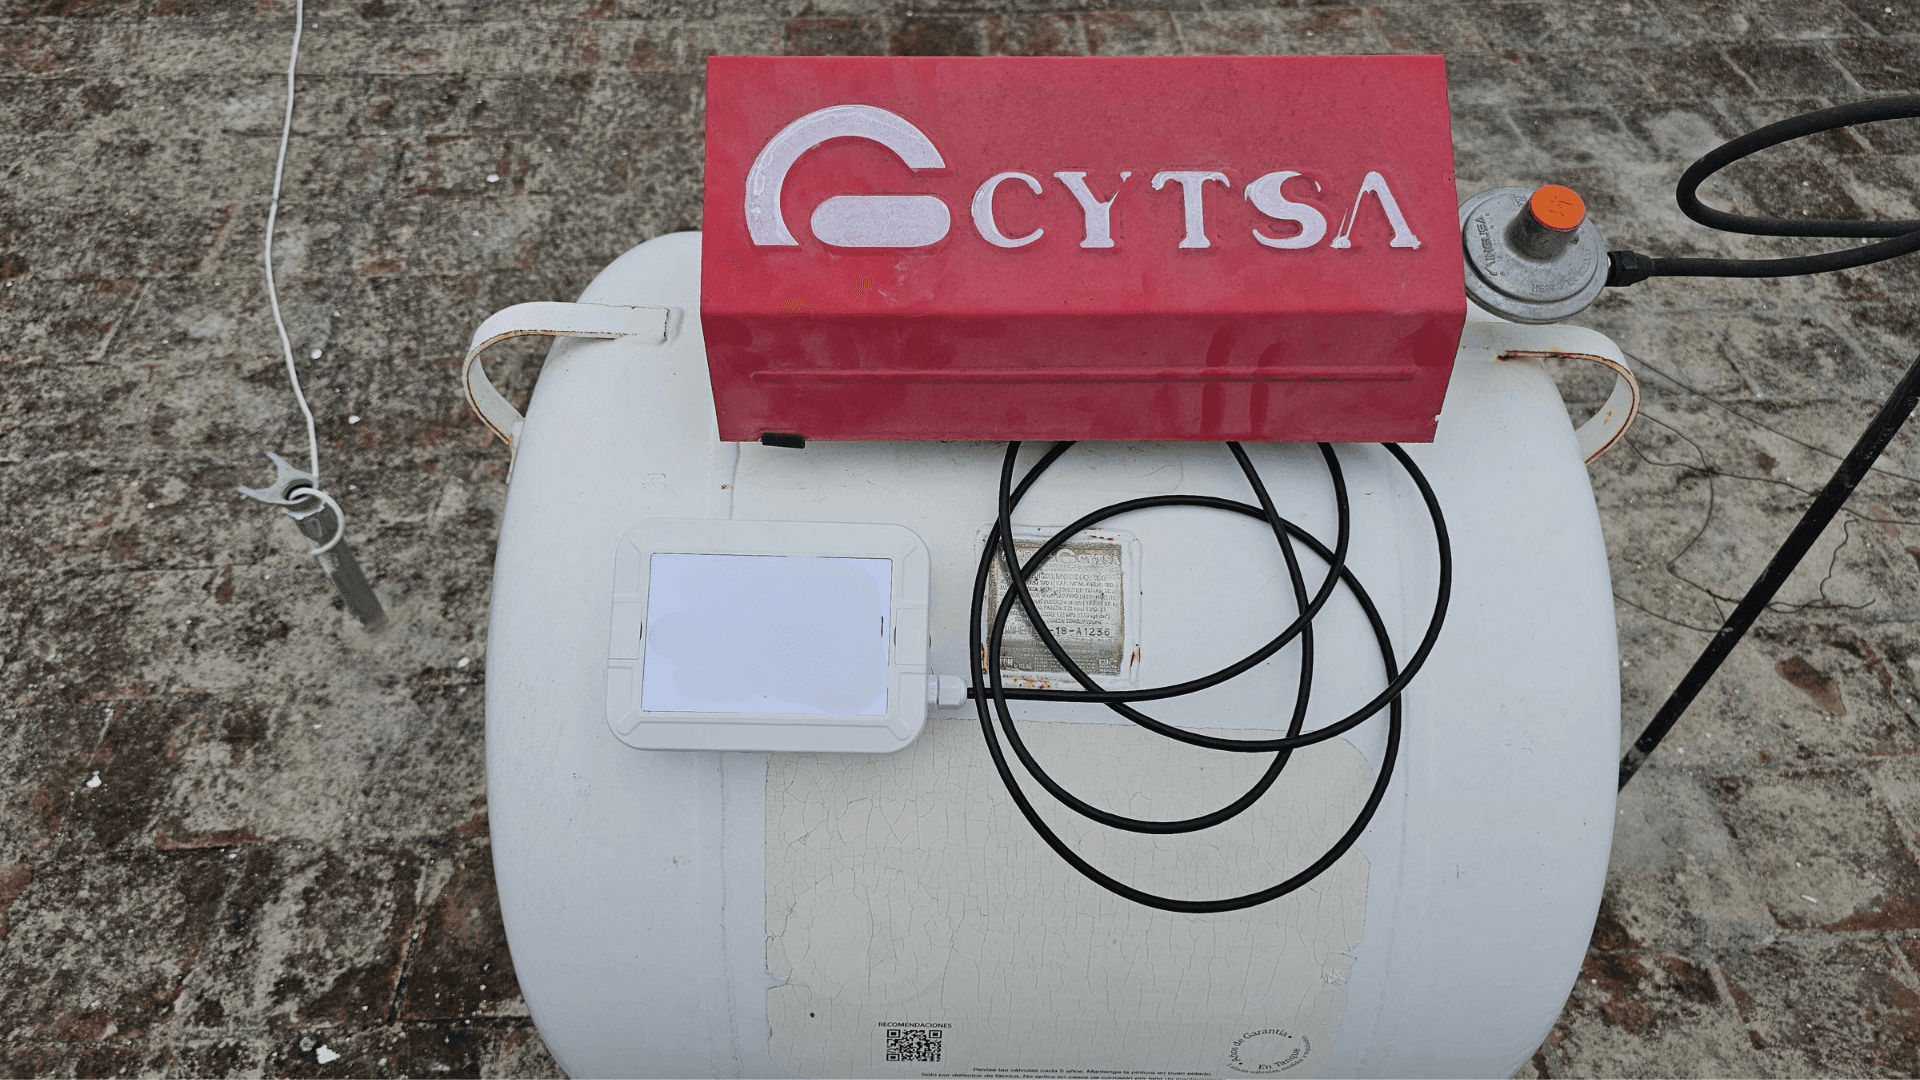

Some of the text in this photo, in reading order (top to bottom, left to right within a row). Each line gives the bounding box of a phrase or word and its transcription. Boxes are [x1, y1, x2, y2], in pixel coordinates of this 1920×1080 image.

[970, 170, 1422, 251] CYTSA
[1077, 554, 1120, 565] CYTSA
[878, 1021, 952, 1029] RECOMENDACIONES
[1229, 1028, 1288, 1062] Años de Garantía
[1273, 1047, 1301, 1067] Tanque
